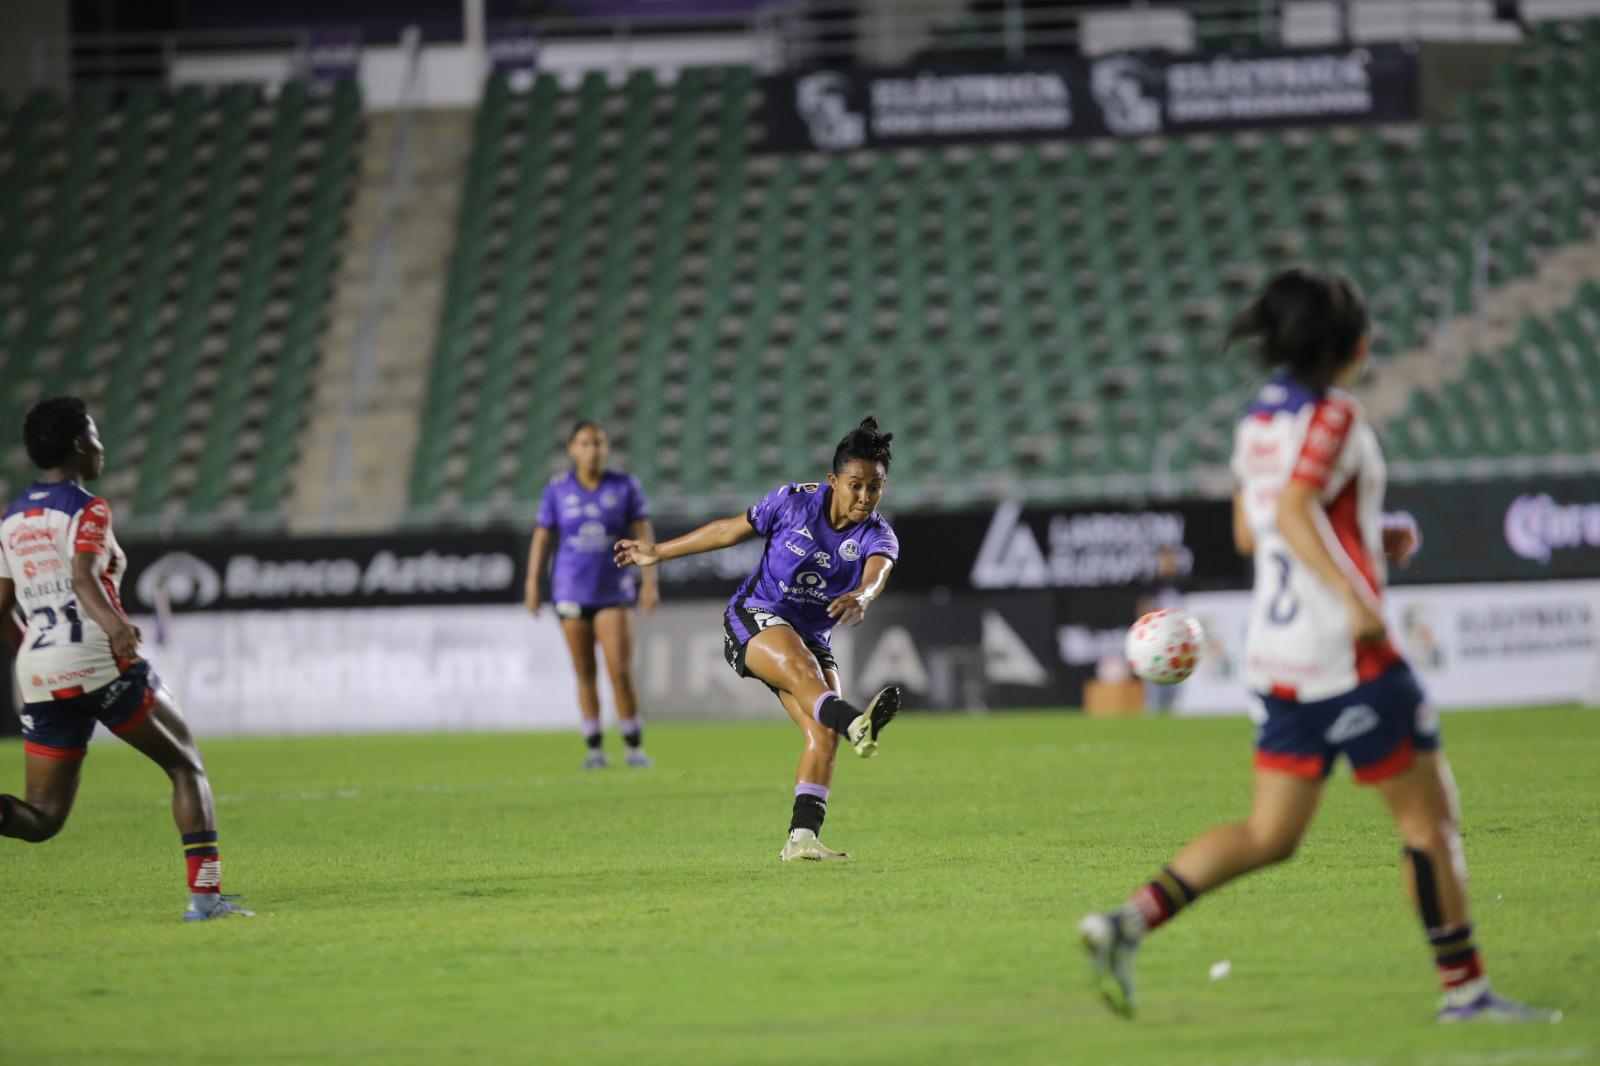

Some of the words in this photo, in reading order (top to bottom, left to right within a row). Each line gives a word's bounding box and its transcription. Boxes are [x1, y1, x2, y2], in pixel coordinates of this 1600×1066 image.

[225, 554, 360, 598] Banco
[364, 550, 515, 594] Azteca
[30, 600, 83, 650] 21
